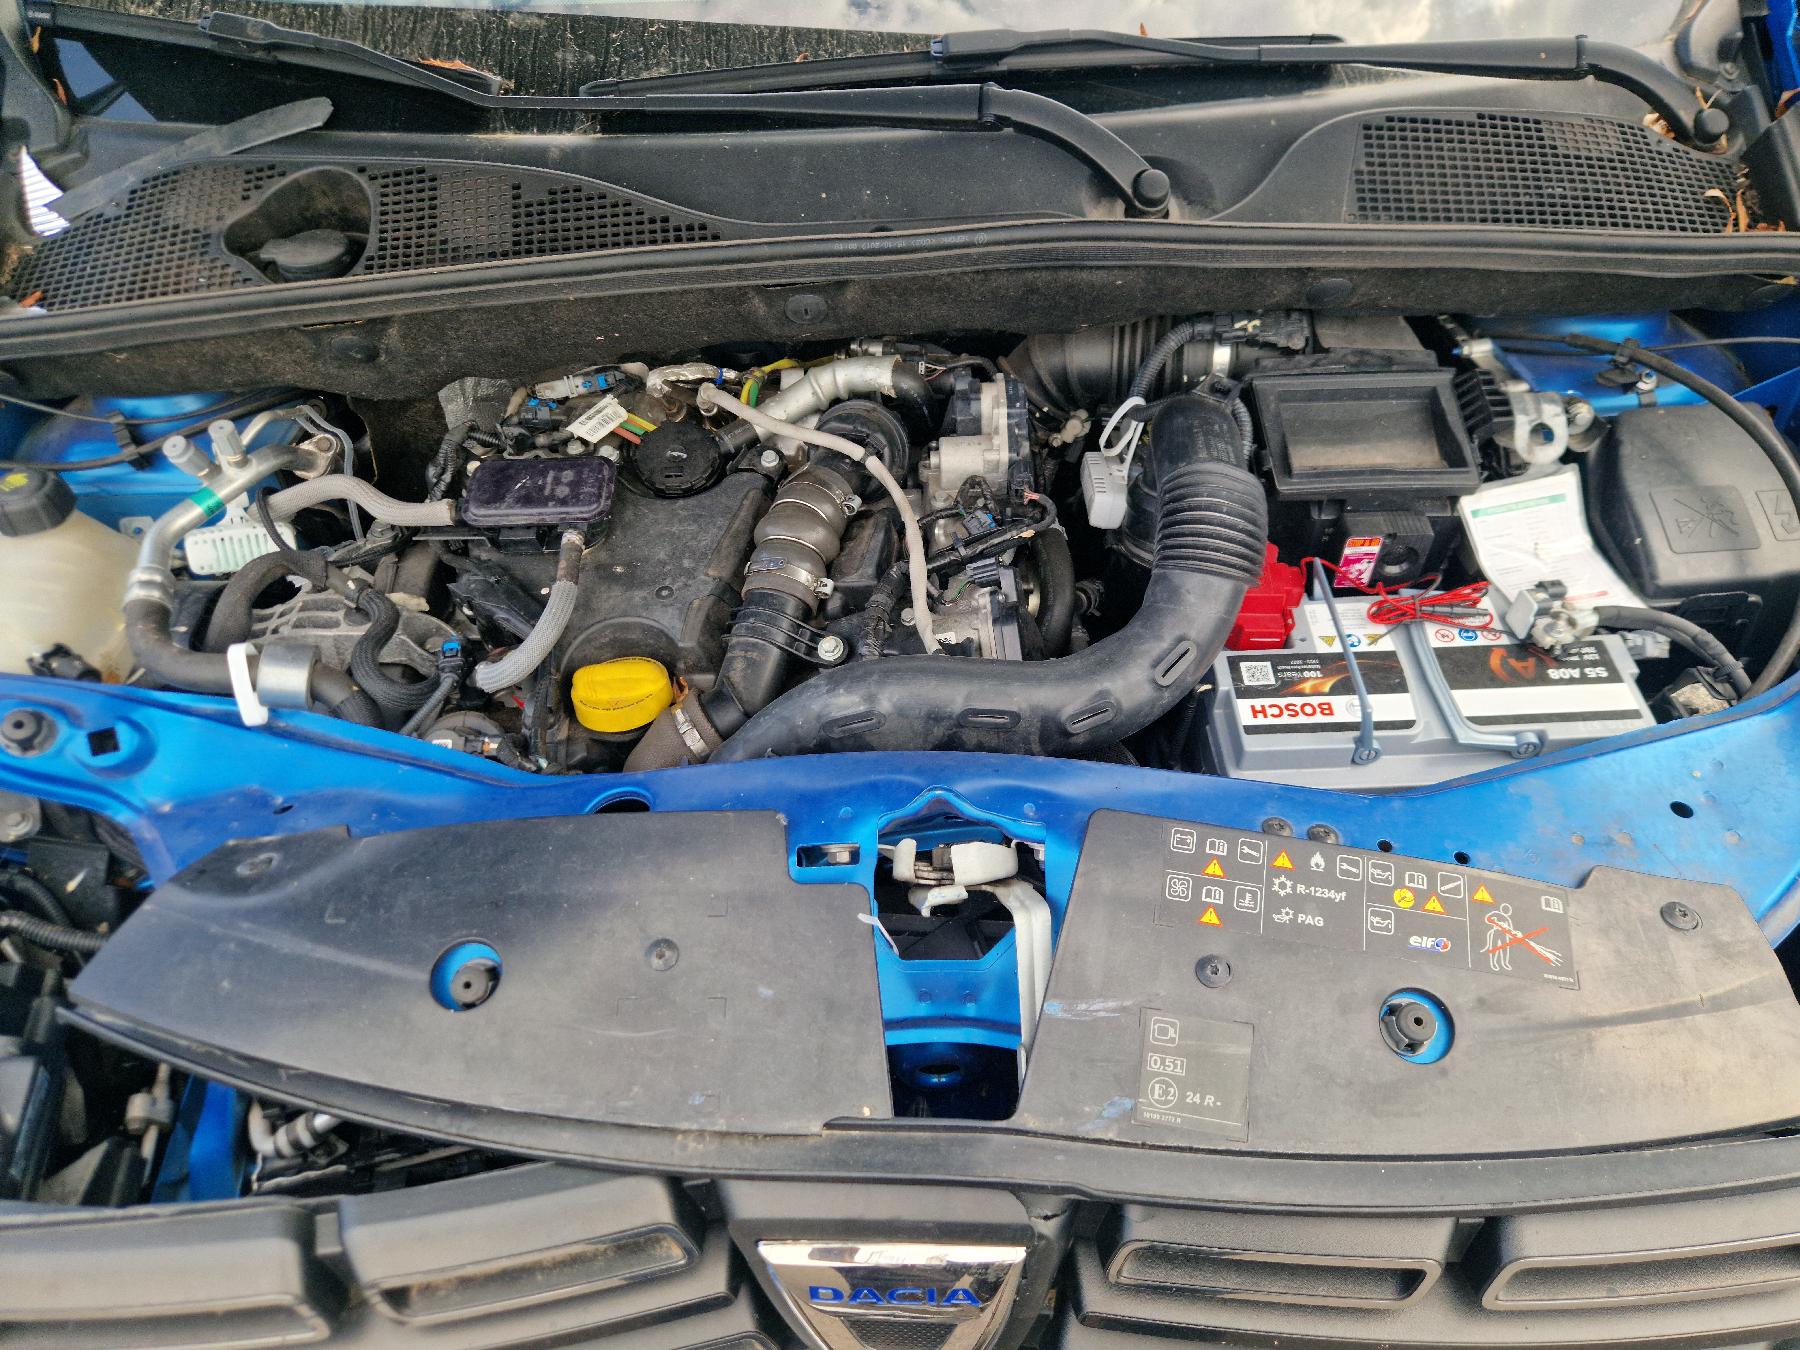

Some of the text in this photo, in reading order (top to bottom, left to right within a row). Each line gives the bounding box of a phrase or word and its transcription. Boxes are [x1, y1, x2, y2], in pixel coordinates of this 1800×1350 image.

[1302, 670, 1323, 678] 100
[1546, 665, 1609, 680] S5 A08
[1250, 702, 1335, 720] BOSCH
[1296, 883, 1347, 903] R-1234yf
[1297, 913, 1325, 927] PAG
[1150, 1055, 1183, 1074] 0,51
[1185, 1091, 1201, 1105] 24
[808, 1285, 984, 1308] DACIA
